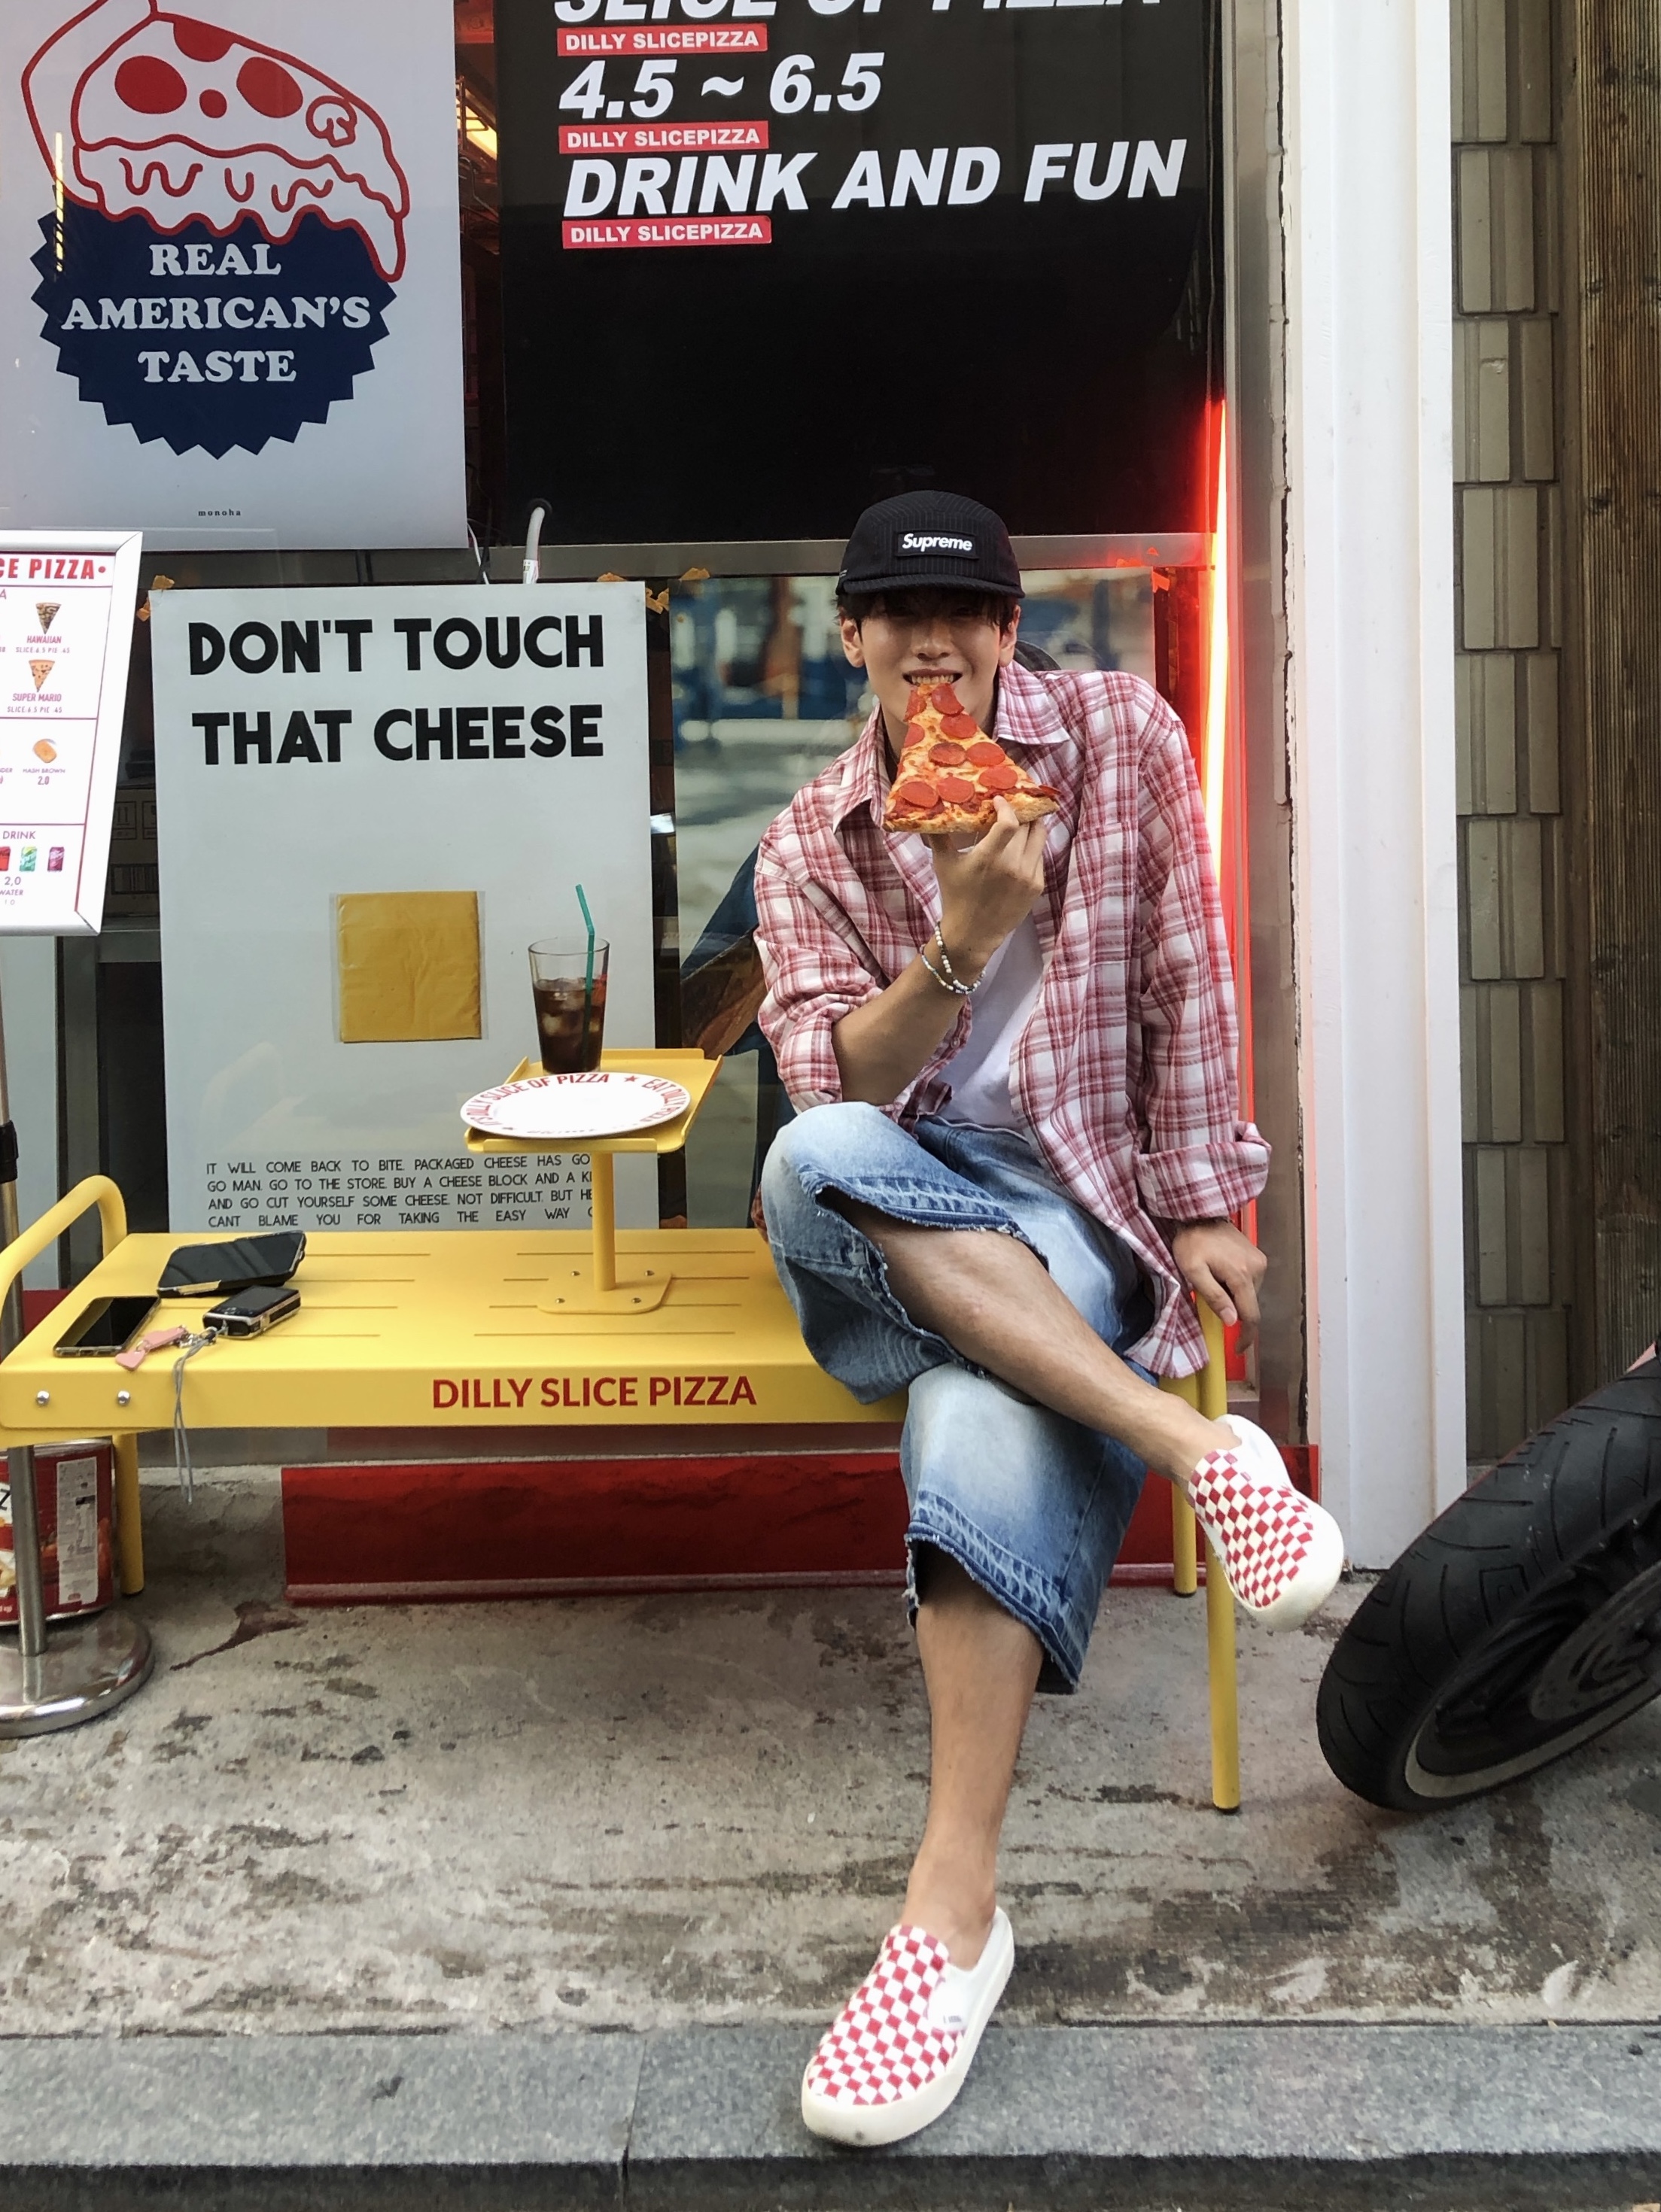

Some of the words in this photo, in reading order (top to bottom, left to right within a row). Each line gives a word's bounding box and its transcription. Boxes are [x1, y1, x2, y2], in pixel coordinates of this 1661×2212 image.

[566, 34, 625, 50] DILLY
[633, 31, 759, 49] SLICEPIZZA
[558, 59, 677, 120] 4.5
[768, 53, 885, 114] 6.5
[567, 129, 627, 148] DILLY
[634, 127, 760, 147] SLICEPIZZA
[563, 153, 817, 217] DRINK
[832, 146, 1001, 211] AND
[1023, 139, 1187, 203] FUN
[570, 225, 630, 243] DILLY
[637, 222, 764, 242] SLICEPIZZA
[149, 244, 281, 276] REAL
[60, 296, 371, 330] AMERICAN'S
[138, 351, 297, 383] TASTE
[198, 508, 241, 516] monoha
[902, 533, 973, 552] Supreme
[26, 635, 62, 643] HAWAIIAN
[188, 619, 373, 675] DON'T
[394, 615, 604, 670] TOUCH
[12, 693, 36, 701] SUPER
[38, 694, 62, 702] MARIO
[191, 709, 352, 765] THAT
[373, 704, 604, 761] CHEESE
[2, 831, 36, 840] DRINK
[527, 1077, 551, 1088] OF
[556, 1074, 610, 1085] PIZZA
[206, 1163, 217, 1174] IT
[227, 1162, 256, 1174] WILL
[266, 1161, 301, 1173] COME
[311, 1160, 342, 1172] BACK
[351, 1160, 369, 1171] TO
[415, 1158, 474, 1170] PACKAGED
[484, 1156, 528, 1168] CHEESE
[537, 1155, 561, 1166] HAS
[207, 1180, 227, 1192] GO
[269, 1179, 287, 1190] GO
[294, 1179, 312, 1190] TO
[319, 1178, 340, 1190] THE
[394, 1177, 416, 1189] BUY
[424, 1177, 432, 1188] A
[440, 1175, 482, 1187] CHEESE
[488, 1174, 528, 1187] BLOCK
[535, 1172, 559, 1184] AND
[566, 1172, 575, 1183] A
[208, 1199, 233, 1210] AND
[240, 1198, 259, 1209] GO
[266, 1197, 289, 1208] CUT
[297, 1196, 355, 1208] YOURSELF
[363, 1195, 397, 1207] SOME
[458, 1193, 482, 1205] NOT
[551, 1190, 573, 1202] BUT
[208, 1216, 241, 1227] CANT
[259, 1214, 298, 1226] BLAME
[316, 1214, 340, 1226] YOU
[357, 1214, 381, 1225] FOR
[399, 1212, 440, 1224] TAKING
[458, 1211, 479, 1222] THE
[496, 1209, 526, 1222] EASY
[545, 1208, 570, 1220] WAY
[433, 1378, 533, 1408] DILLY
[540, 1377, 638, 1407] SLICE
[649, 1376, 757, 1406] PIZZA
